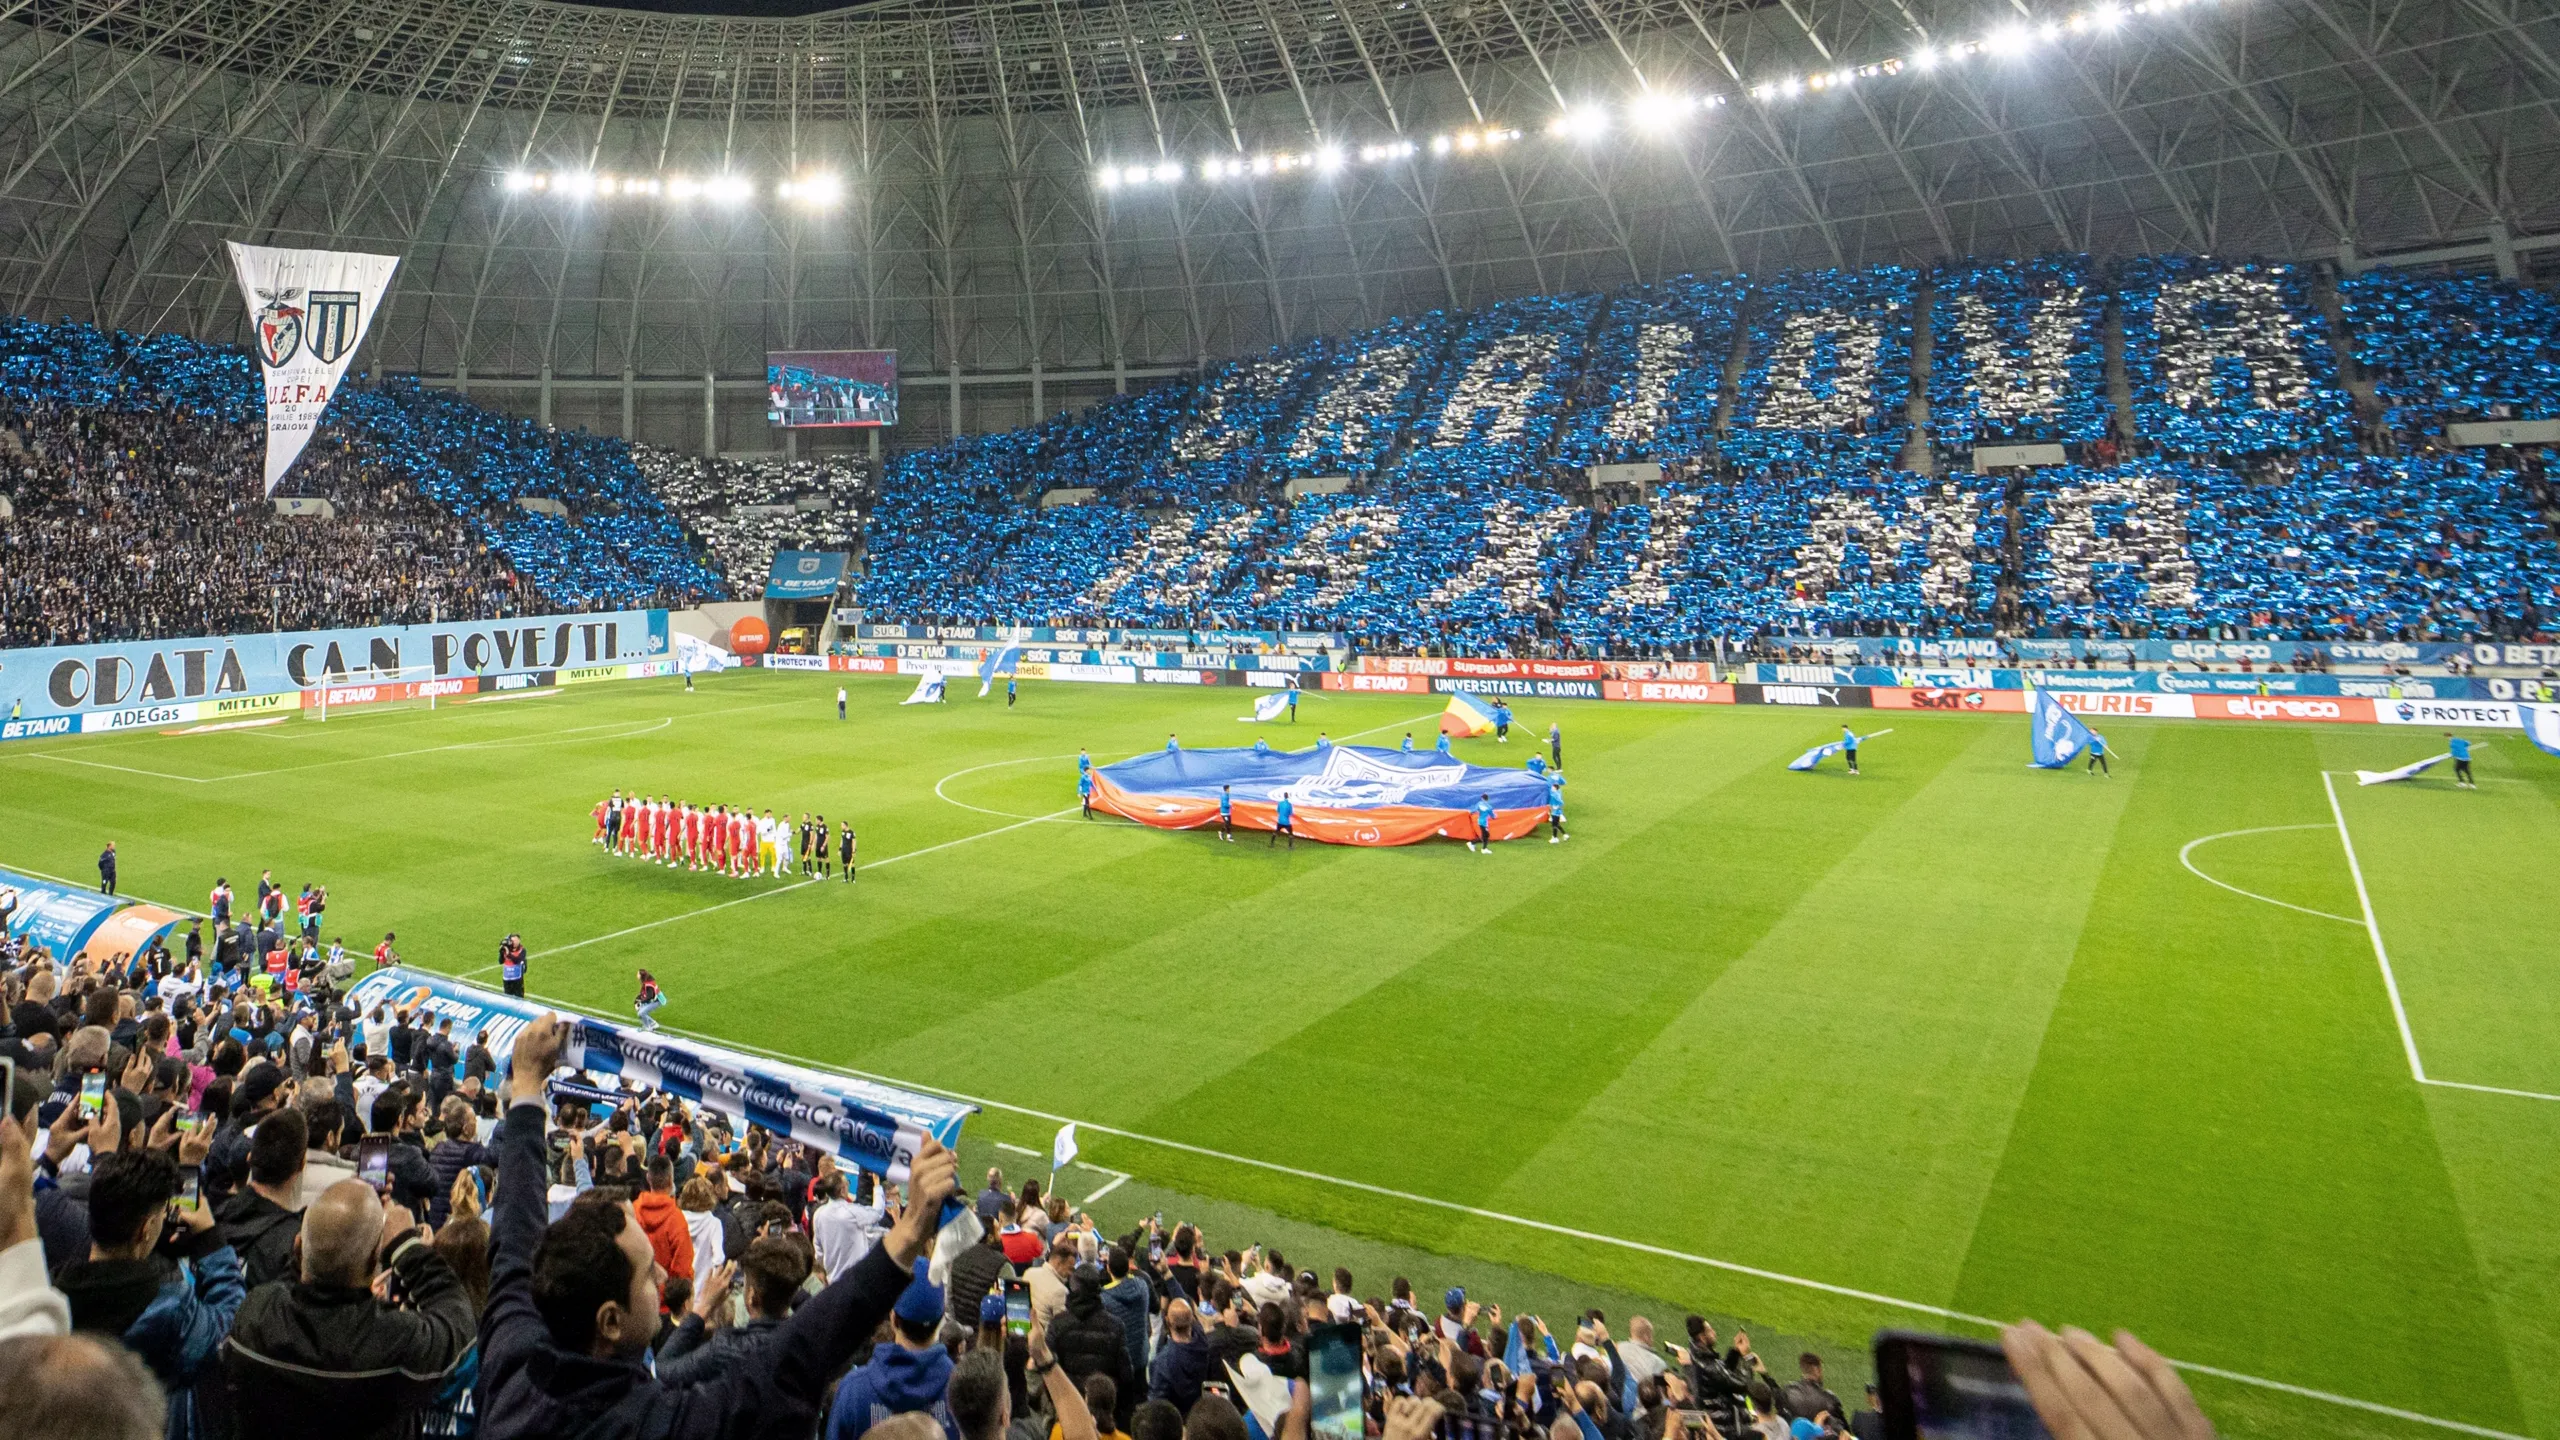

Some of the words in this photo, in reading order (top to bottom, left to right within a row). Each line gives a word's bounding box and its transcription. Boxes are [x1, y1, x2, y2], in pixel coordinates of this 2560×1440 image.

[298, 413, 318, 421] 1983
[271, 423, 309, 431] CRAIOVA
[784, 577, 836, 587] BETANO
[995, 627, 1034, 638] RUIS
[908, 645, 947, 657] BETANO
[960, 646, 994, 656] PROTCT
[777, 658, 807, 667] PROTECT
[808, 659, 823, 667] NPG
[848, 658, 885, 671] BETANO
[1259, 655, 1300, 670] PUMA
[1388, 659, 1447, 674] BETANO
[1453, 661, 1517, 675] SUPERLIGA
[1533, 663, 1594, 677] SUPERBET
[49, 639, 248, 708] ODATĂ
[287, 637, 400, 687] CA-N
[570, 667, 613, 679] MITLIV
[1246, 671, 1286, 687] PUMA
[1776, 665, 1835, 683] PUMA
[418, 680, 464, 697] BETANO
[496, 674, 527, 690] PUMA
[1353, 675, 1408, 691] BETANO
[1434, 678, 1534, 695] UNIVERSITATEA
[1537, 681, 1598, 697] CRAIOVA
[328, 687, 378, 705] BETANO
[1642, 683, 1709, 700] BETANO
[1762, 686, 1820, 705] PUMA
[218, 696, 281, 712] MITLIV
[2059, 694, 2153, 713] RURIS
[2228, 696, 2340, 719] elpreco
[112, 706, 179, 727] ADEGas
[2421, 706, 2511, 722] PROTECT
[2, 717, 70, 739] BETANO
[420, 997, 482, 1022] BETANO
